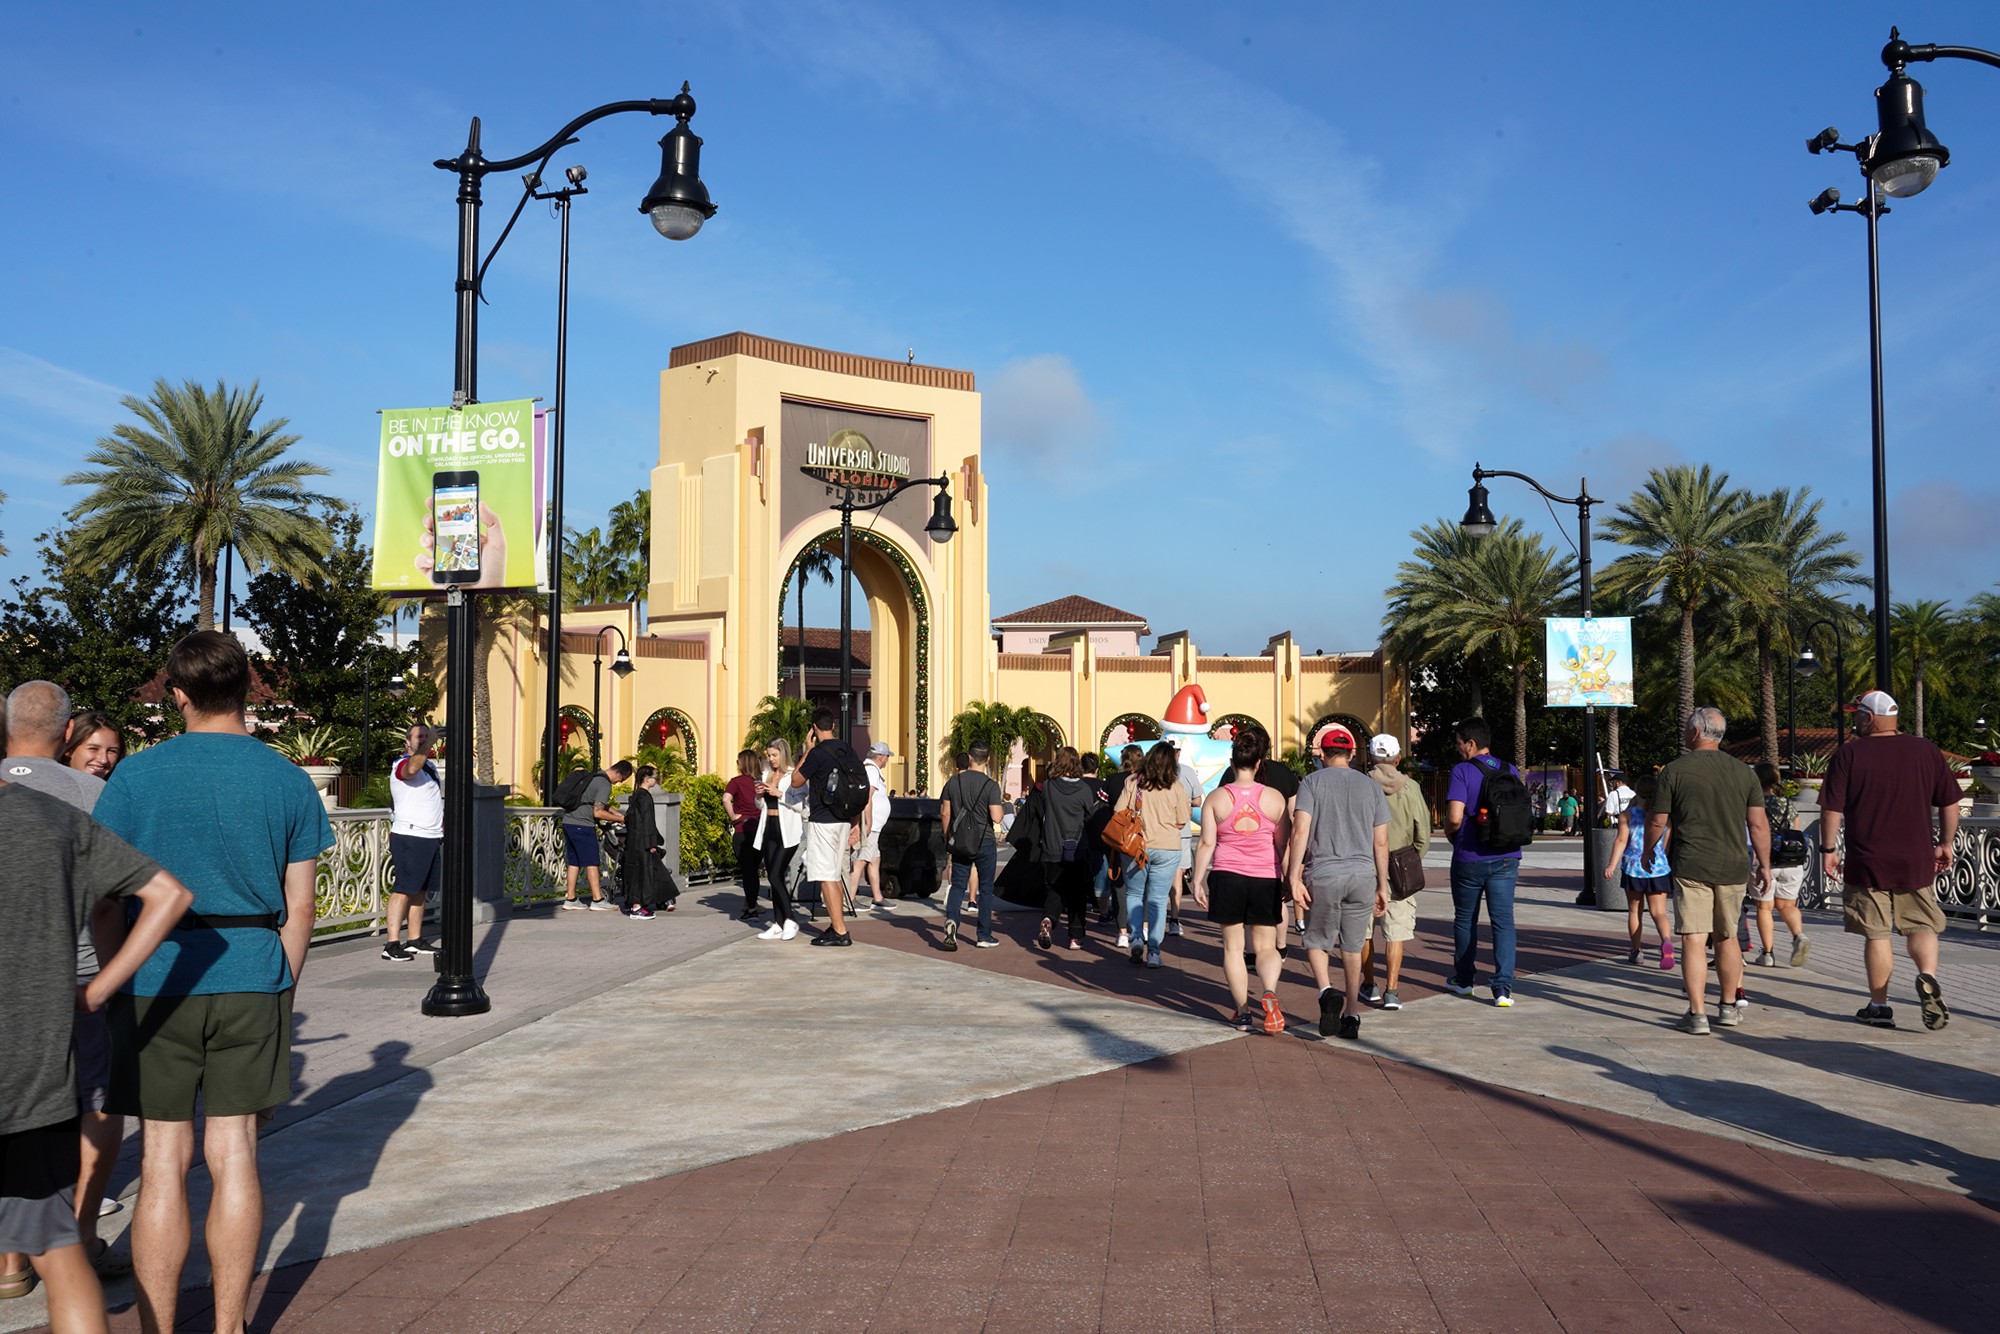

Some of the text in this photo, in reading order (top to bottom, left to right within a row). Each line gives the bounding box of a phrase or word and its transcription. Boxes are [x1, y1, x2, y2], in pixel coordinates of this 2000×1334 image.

[389, 410, 520, 434] BE IN THE KNOW
[389, 427, 525, 457] ON THE GO.
[808, 443, 910, 475] UNIVERSAL STUDIOS
[829, 472, 897, 489] FLORIDA
[1551, 620, 1626, 633] WELCOME
